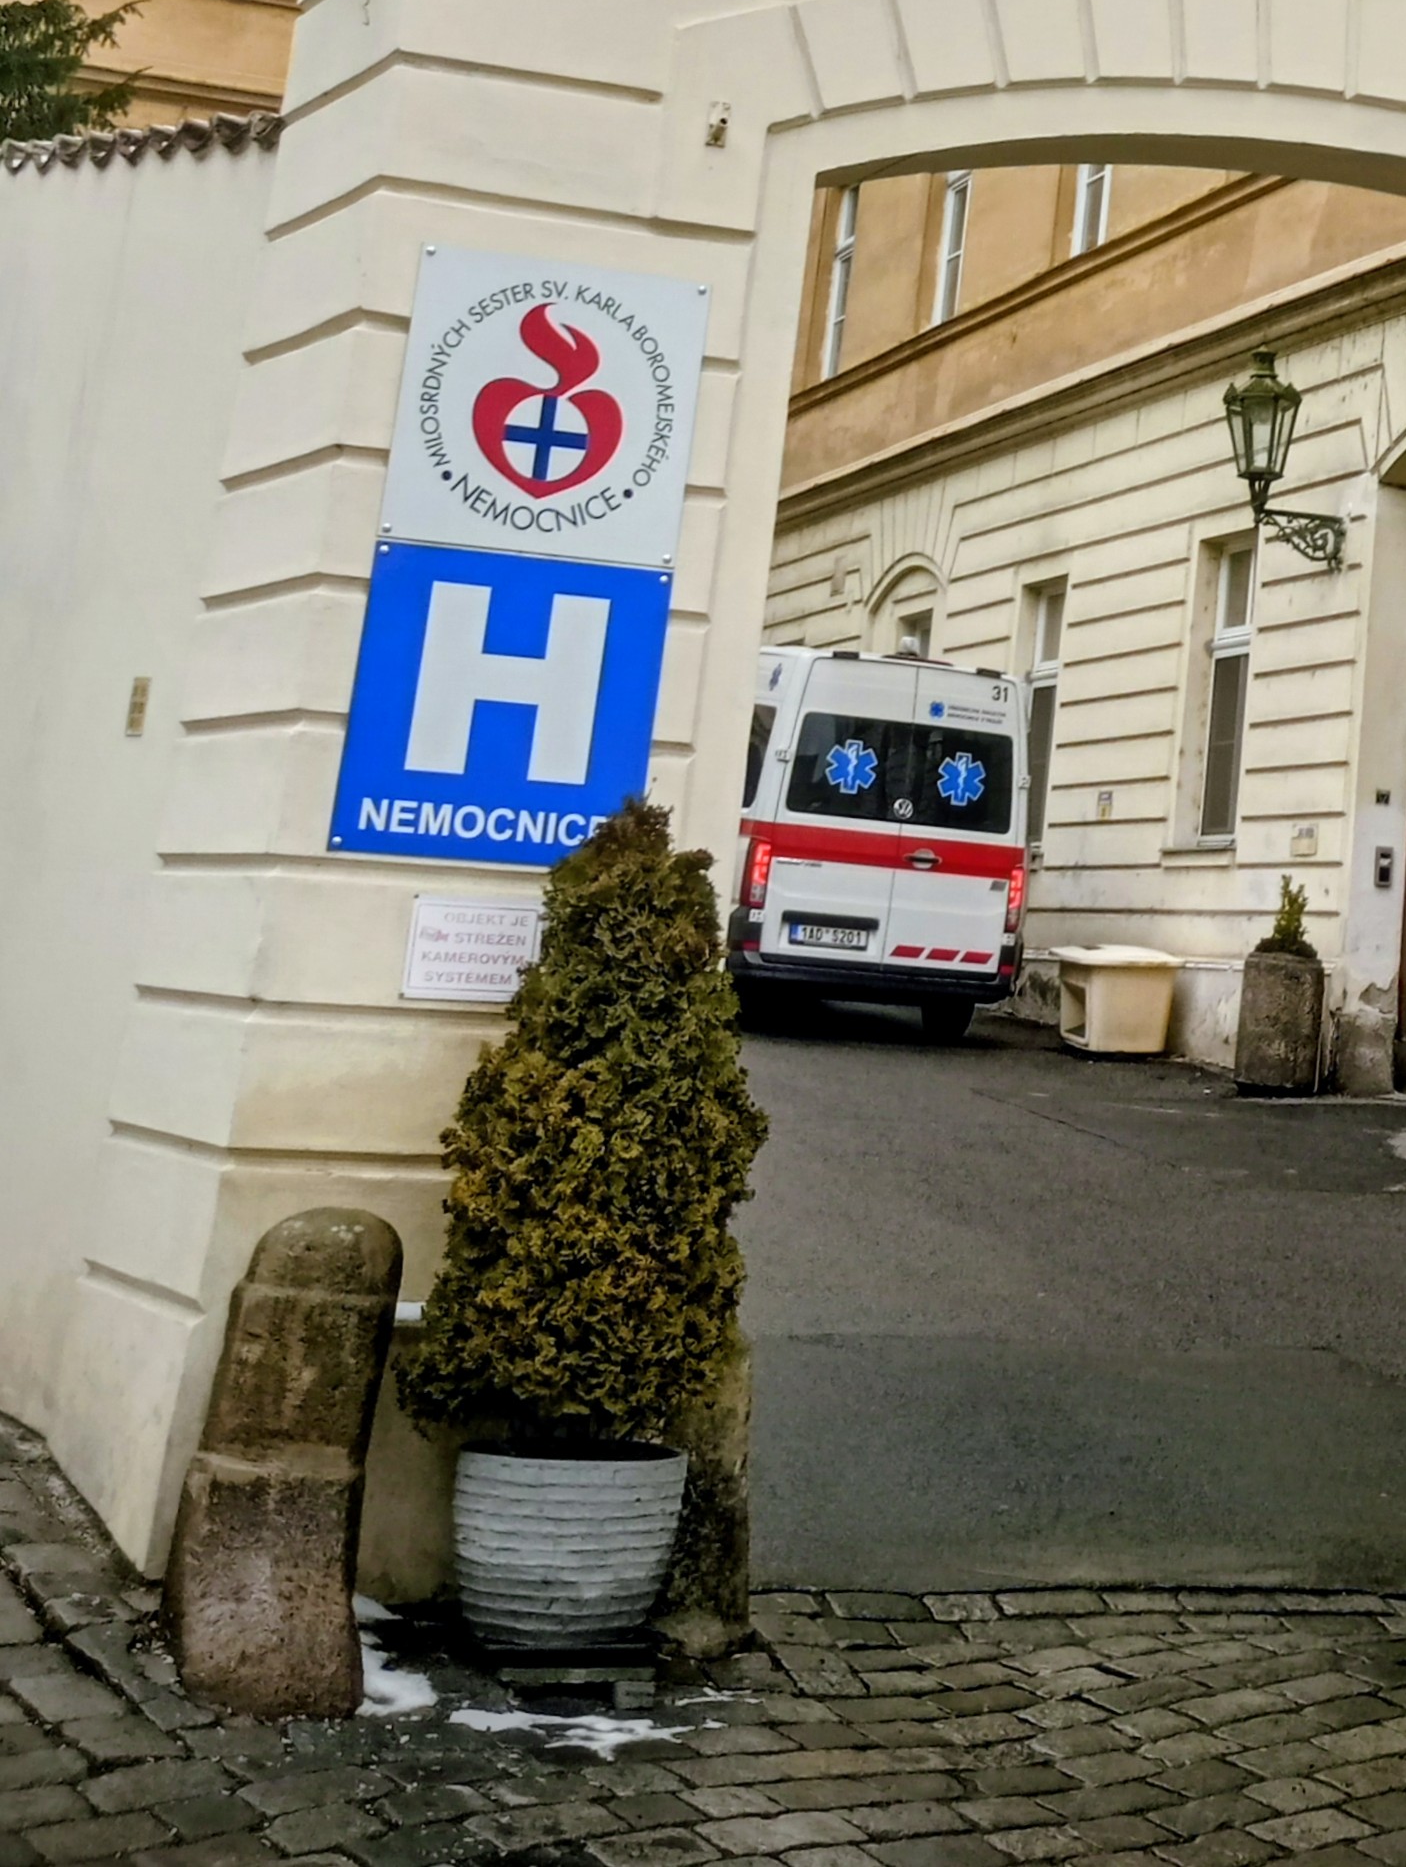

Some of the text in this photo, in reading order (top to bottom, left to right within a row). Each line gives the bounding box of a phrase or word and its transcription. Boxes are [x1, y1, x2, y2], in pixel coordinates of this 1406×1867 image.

[420, 280, 675, 487] MILOSRDNÝCH SESTER SV. KARLA BOROMEJSKÉHO
[451, 473, 622, 533] NEMOCNICE
[404, 580, 611, 785] H
[992, 685, 1009, 703] 31
[444, 912, 529, 927] OBJEKT JE
[420, 950, 526, 966] KAMEROVÝM
